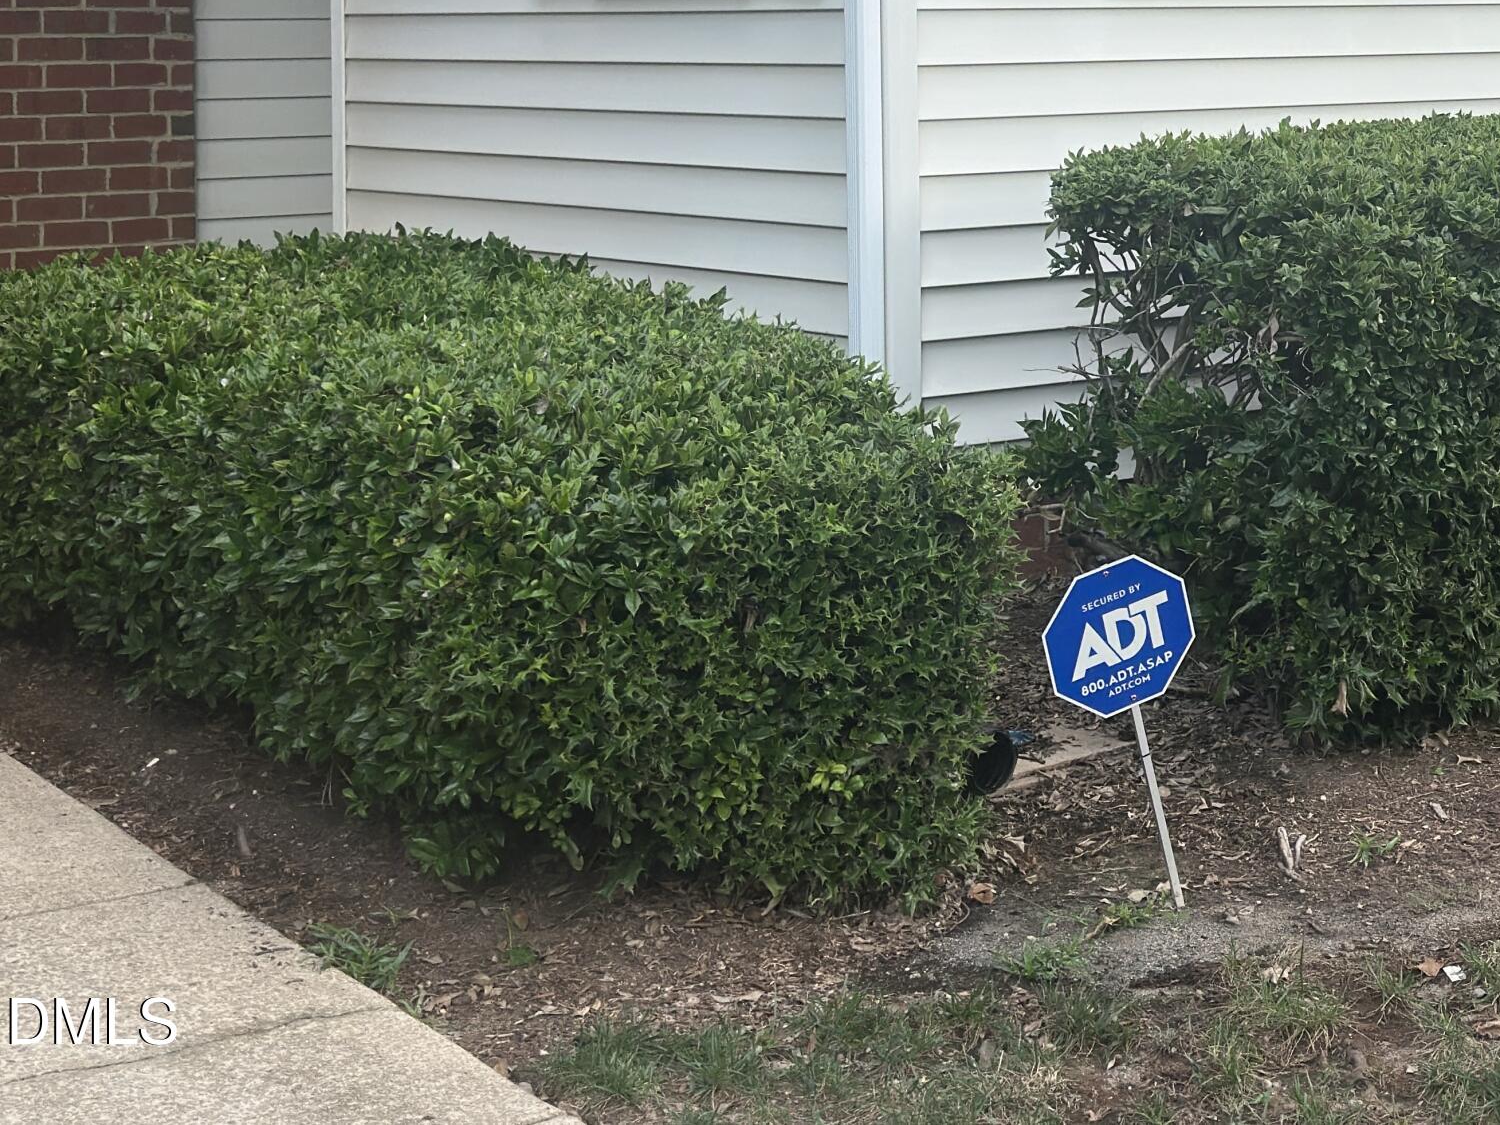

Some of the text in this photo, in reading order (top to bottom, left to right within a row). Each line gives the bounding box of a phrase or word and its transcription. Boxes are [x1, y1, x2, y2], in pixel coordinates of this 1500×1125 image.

[1081, 583, 1141, 613] SECURED BY
[1072, 590, 1168, 683] ADT
[1081, 650, 1173, 697] 800.ADT.ASAP
[1108, 673, 1151, 698] ADT.COM
